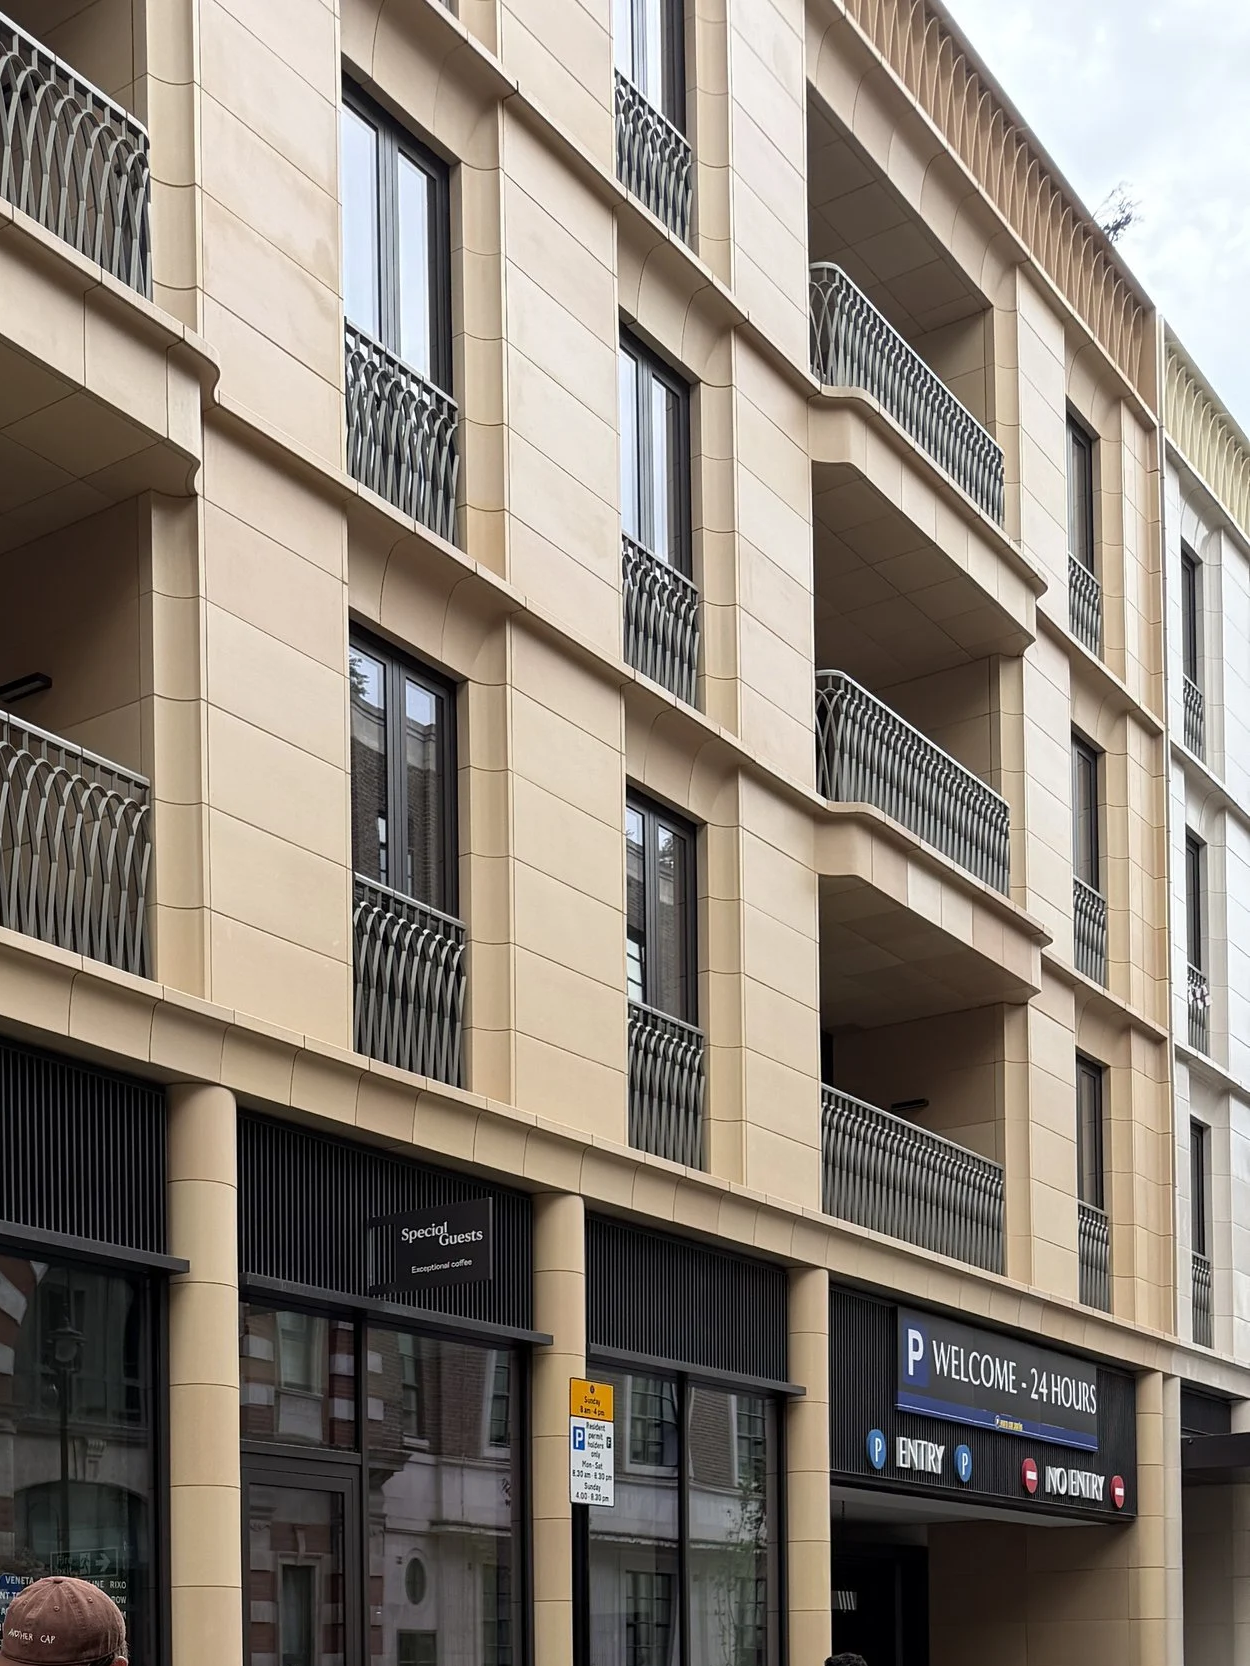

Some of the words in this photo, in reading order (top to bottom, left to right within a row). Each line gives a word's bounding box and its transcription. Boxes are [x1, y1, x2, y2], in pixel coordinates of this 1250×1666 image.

[401, 1221, 448, 1244] Special
[439, 1230, 484, 1246] Guests
[411, 1262, 450, 1274] Exceptional
[451, 1259, 473, 1268] coffee
[907, 1328, 924, 1376] P
[932, 1340, 1018, 1395] WELCOME
[1030, 1367, 1048, 1402] 24
[1051, 1373, 1097, 1415] HOURS
[584, 1395, 600, 1407] Sunday
[586, 1421, 606, 1432] Resident
[588, 1432, 604, 1441] permit
[587, 1441, 604, 1450] holders
[591, 1450, 600, 1459] only
[896, 1437, 945, 1474] ENTRY
[584, 1481, 601, 1493] Sunday
[1045, 1466, 1067, 1495] NO
[1068, 1470, 1105, 1501] ENTRY
[5, 1575, 34, 1585] VENETA
[110, 1581, 127, 1589] RIXO
[40, 1635, 56, 1644] CAP
